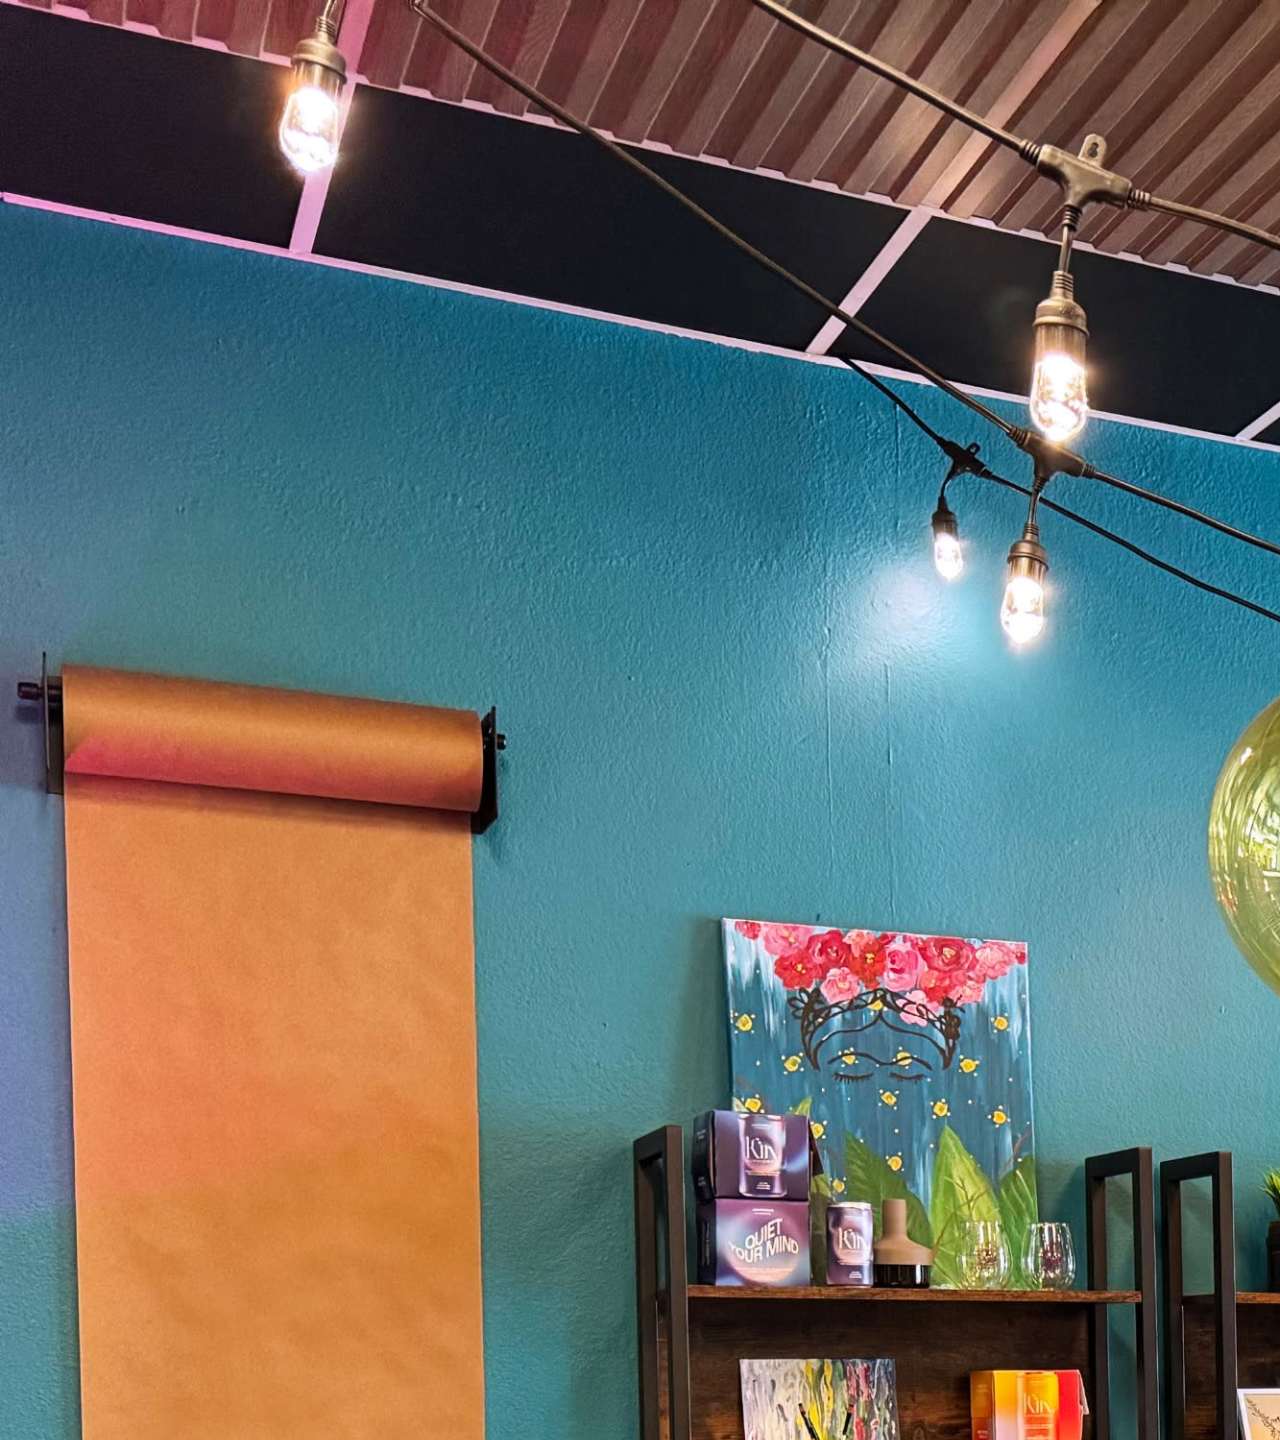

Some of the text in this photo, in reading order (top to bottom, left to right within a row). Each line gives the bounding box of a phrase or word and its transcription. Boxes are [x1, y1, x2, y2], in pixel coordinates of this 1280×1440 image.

[745, 1218, 783, 1248] QUIET
[728, 1236, 799, 1263] YOUR MIND
